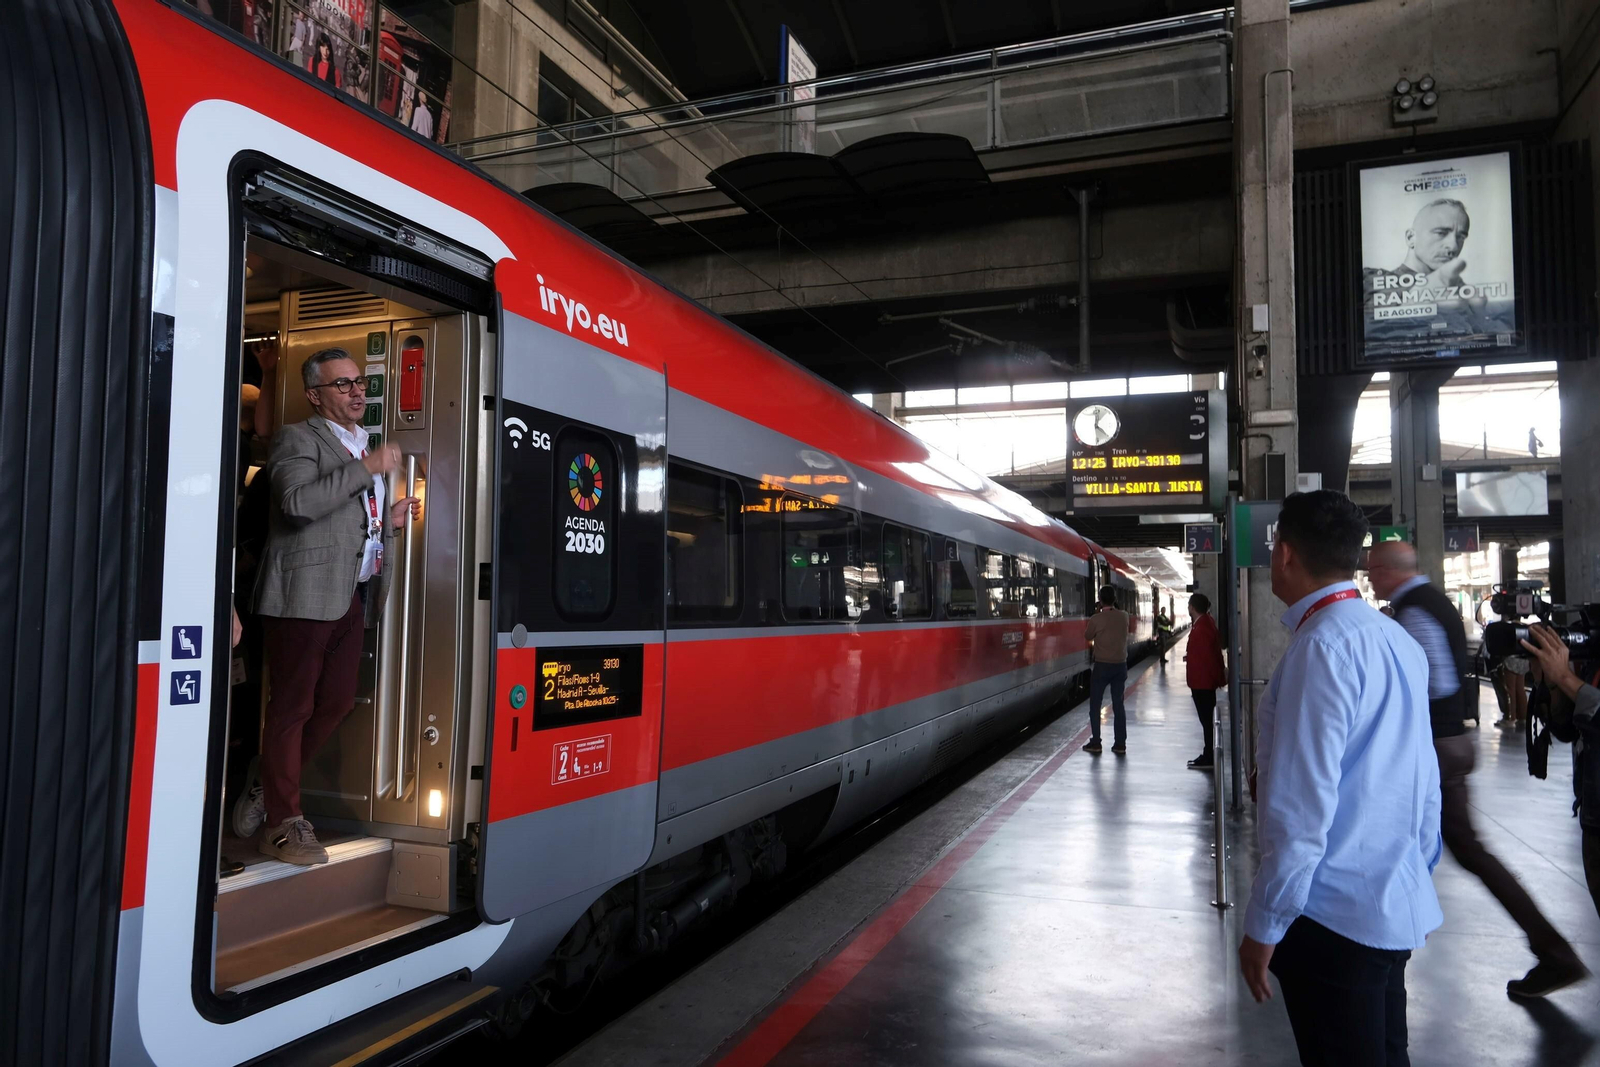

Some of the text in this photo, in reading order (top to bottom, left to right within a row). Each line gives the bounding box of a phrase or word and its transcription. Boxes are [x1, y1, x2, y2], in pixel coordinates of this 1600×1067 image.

[1373, 282, 1507, 306] RAMAZZOTTI
[536, 273, 629, 347] iryo.eu
[1391, 306, 1433, 317] AGOSTO
[532, 430, 551, 451] 5G
[1072, 457, 1107, 470] 12:25
[1072, 475, 1097, 483] Destino
[1086, 481, 1160, 495] VILLA-SANTA
[565, 515, 605, 533] AGENDA
[565, 530, 605, 555] 2030
[1189, 537, 1213, 551] 3 A
[1449, 537, 1475, 551] 4 A
[558, 658, 619, 675] iryo 39130
[544, 679, 555, 700] 2
[590, 672, 600, 683] 1-9
[557, 686, 578, 699] Madrid
[559, 751, 568, 775] 2
[593, 761, 602, 773] 1-9
